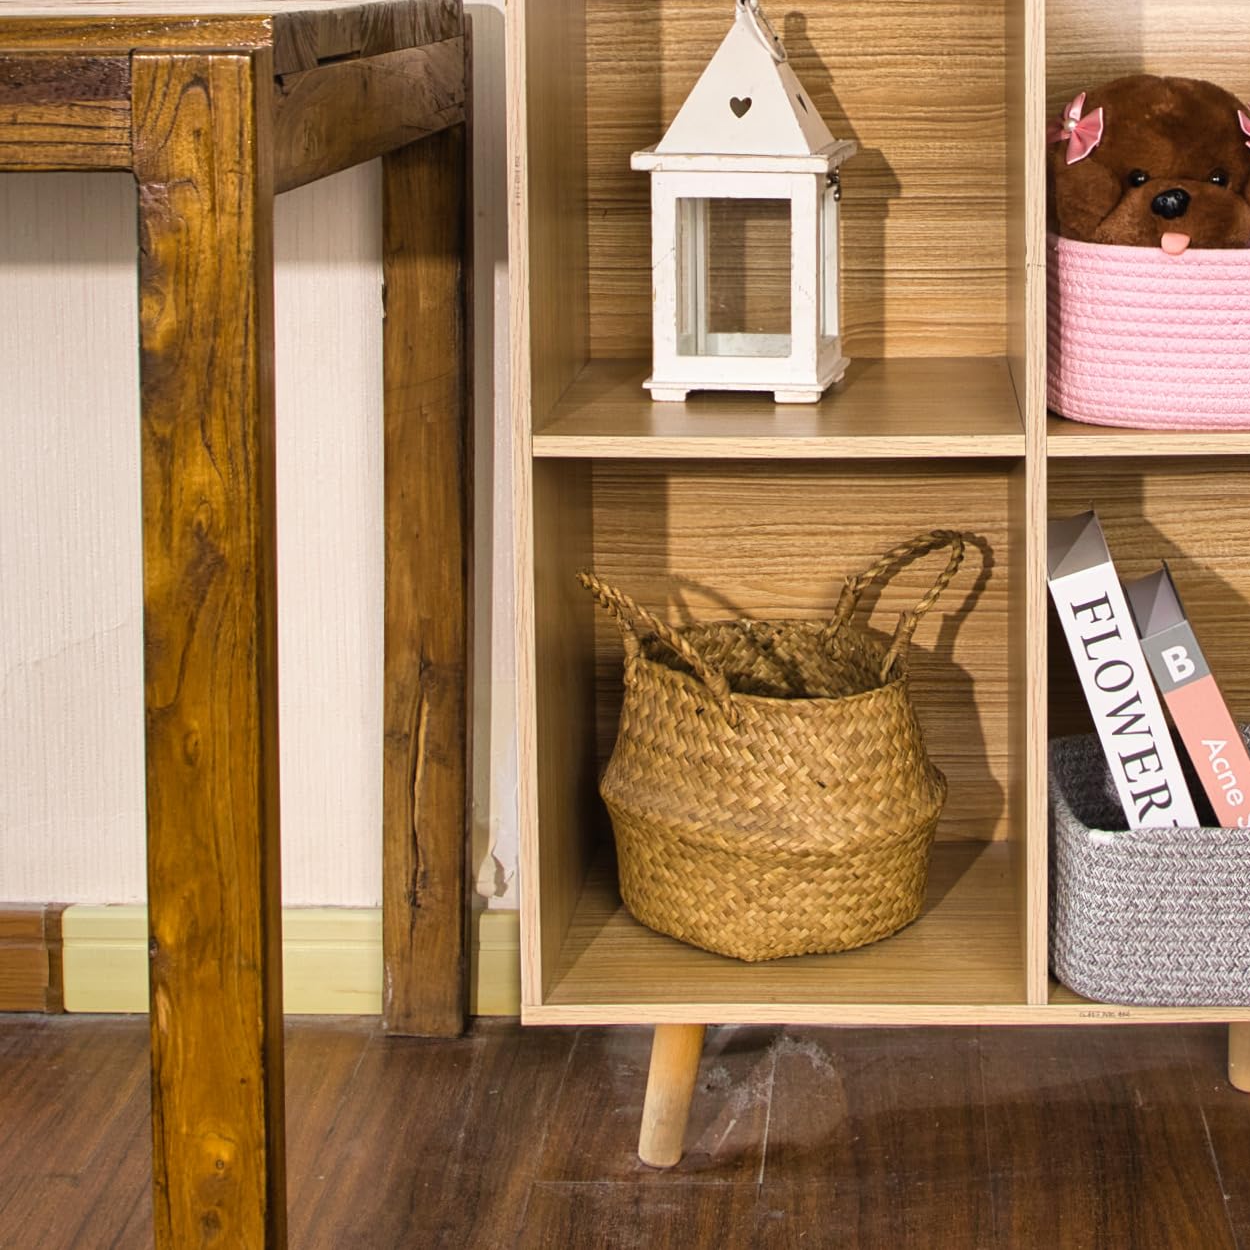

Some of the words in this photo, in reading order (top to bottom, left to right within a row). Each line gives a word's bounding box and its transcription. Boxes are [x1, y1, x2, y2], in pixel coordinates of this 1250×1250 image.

[1161, 645, 1196, 683] B
[1070, 591, 1179, 828] FLOWER
[1201, 738, 1244, 807] Acne
